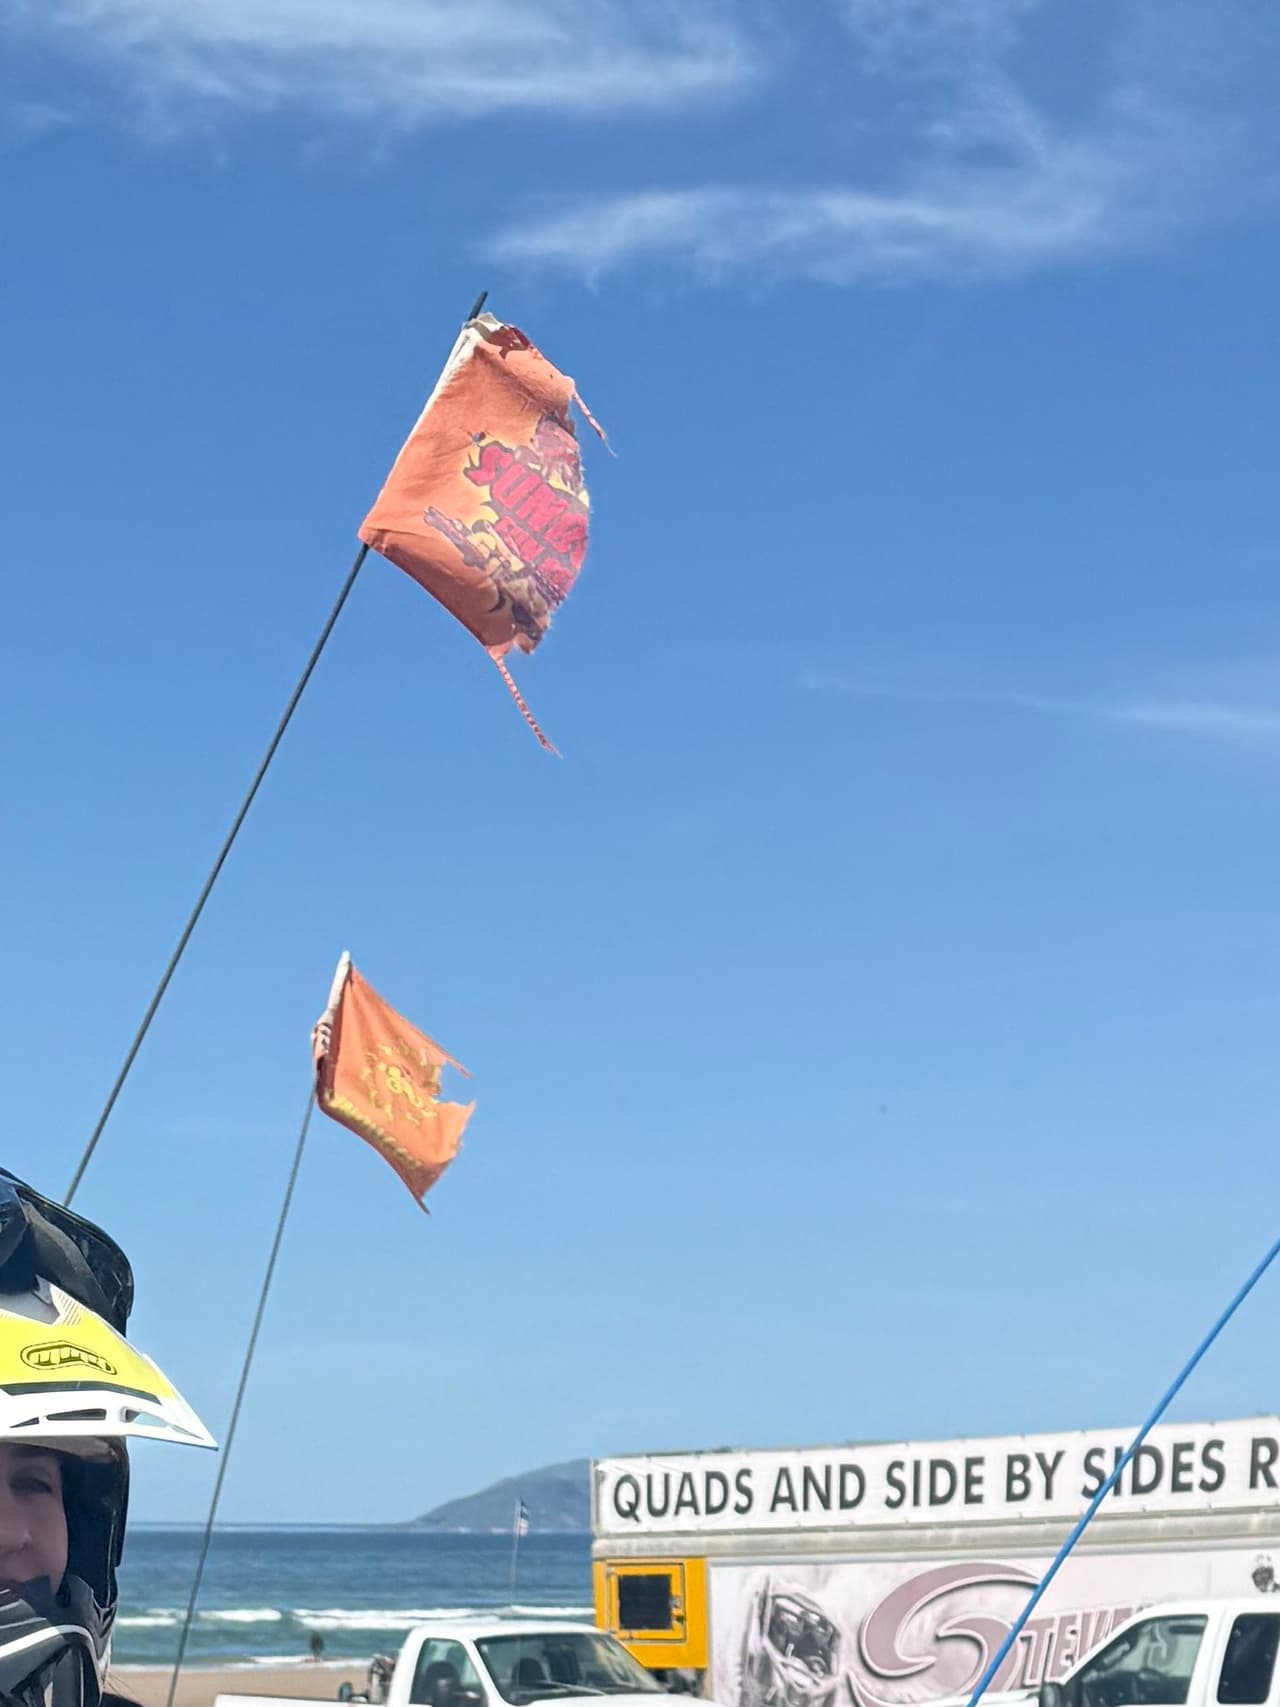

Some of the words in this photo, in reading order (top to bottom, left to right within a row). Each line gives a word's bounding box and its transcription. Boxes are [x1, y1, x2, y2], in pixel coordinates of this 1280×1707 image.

[613, 1467, 754, 1522] QUADS
[769, 1463, 867, 1513] AND
[884, 1456, 986, 1509] SIDE
[1005, 1449, 1065, 1502] BY
[1080, 1439, 1227, 1500] SIDES
